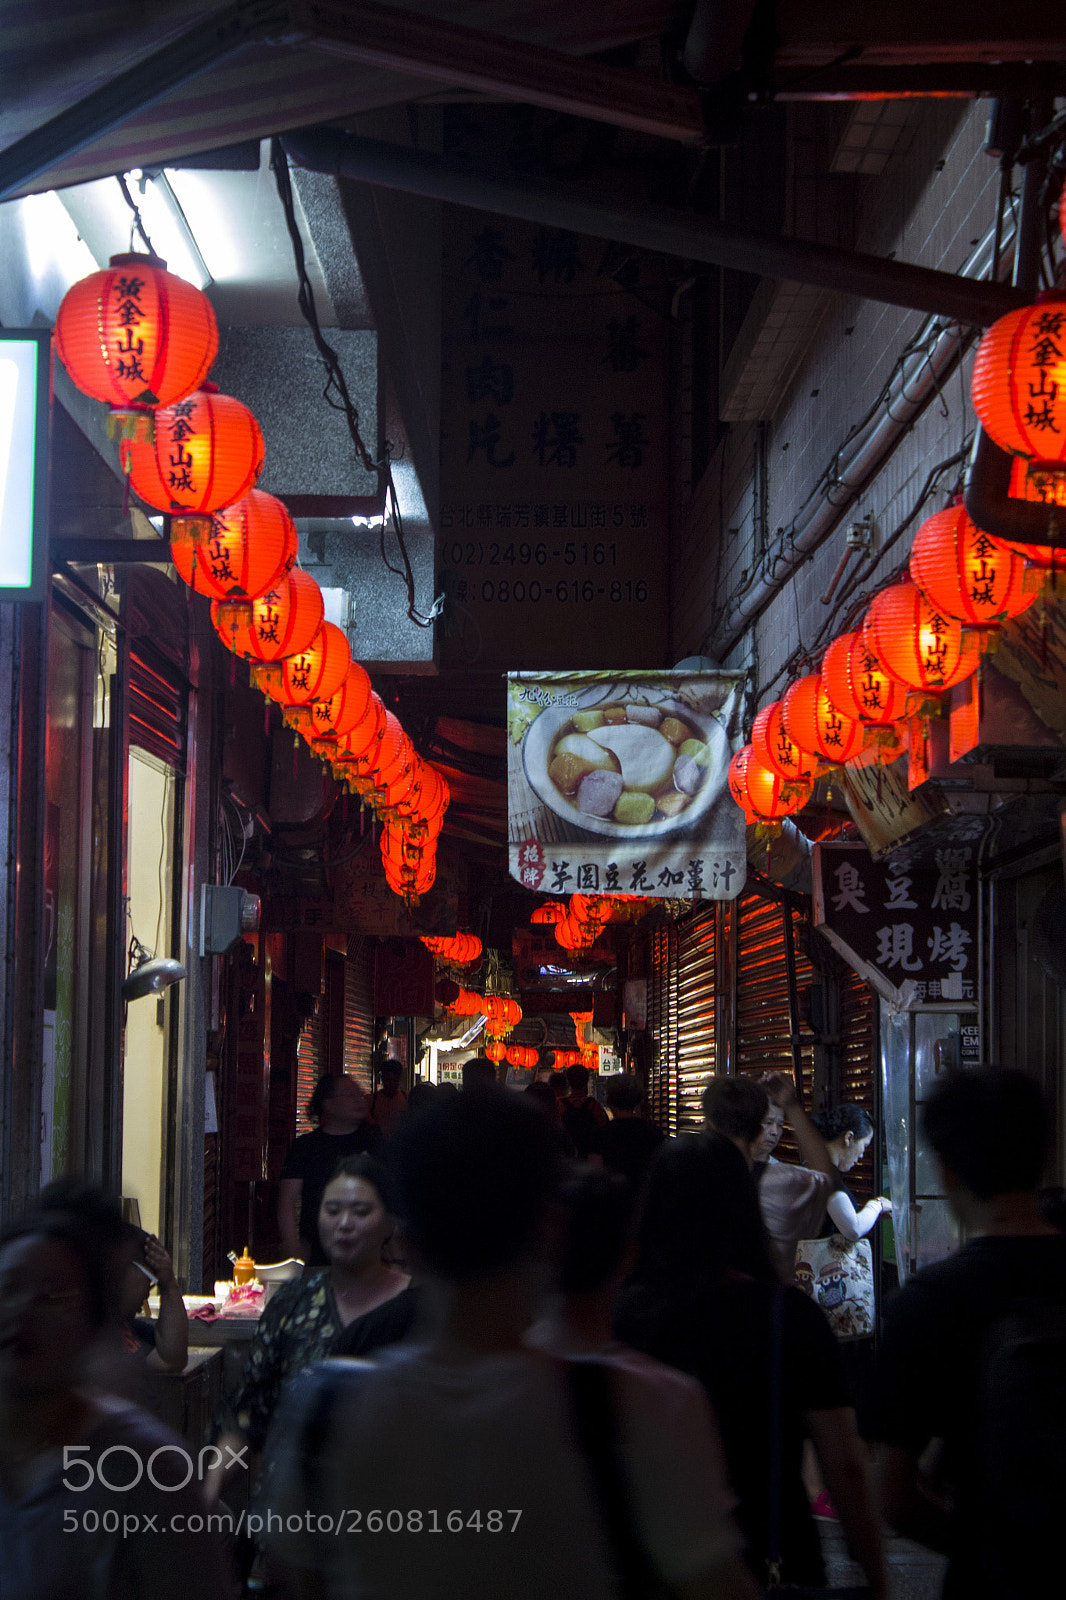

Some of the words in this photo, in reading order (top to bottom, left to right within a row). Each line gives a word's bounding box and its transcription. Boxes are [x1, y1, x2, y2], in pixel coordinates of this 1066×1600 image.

[113, 277, 148, 384] 黃金山城
[1023, 312, 1066, 435] 黃金山城
[168, 400, 198, 493] 黃金山城
[442, 542, 618, 566] (02)2496-5161
[969, 524, 998, 606] 金山城
[291, 647, 314, 692] 山城
[924, 604, 950, 676] 金山城
[522, 844, 540, 886] 招牌
[550, 860, 737, 893] 芋圓豆花加薑汁
[830, 847, 974, 914] 臭豆腐
[875, 922, 974, 972] 現烤
